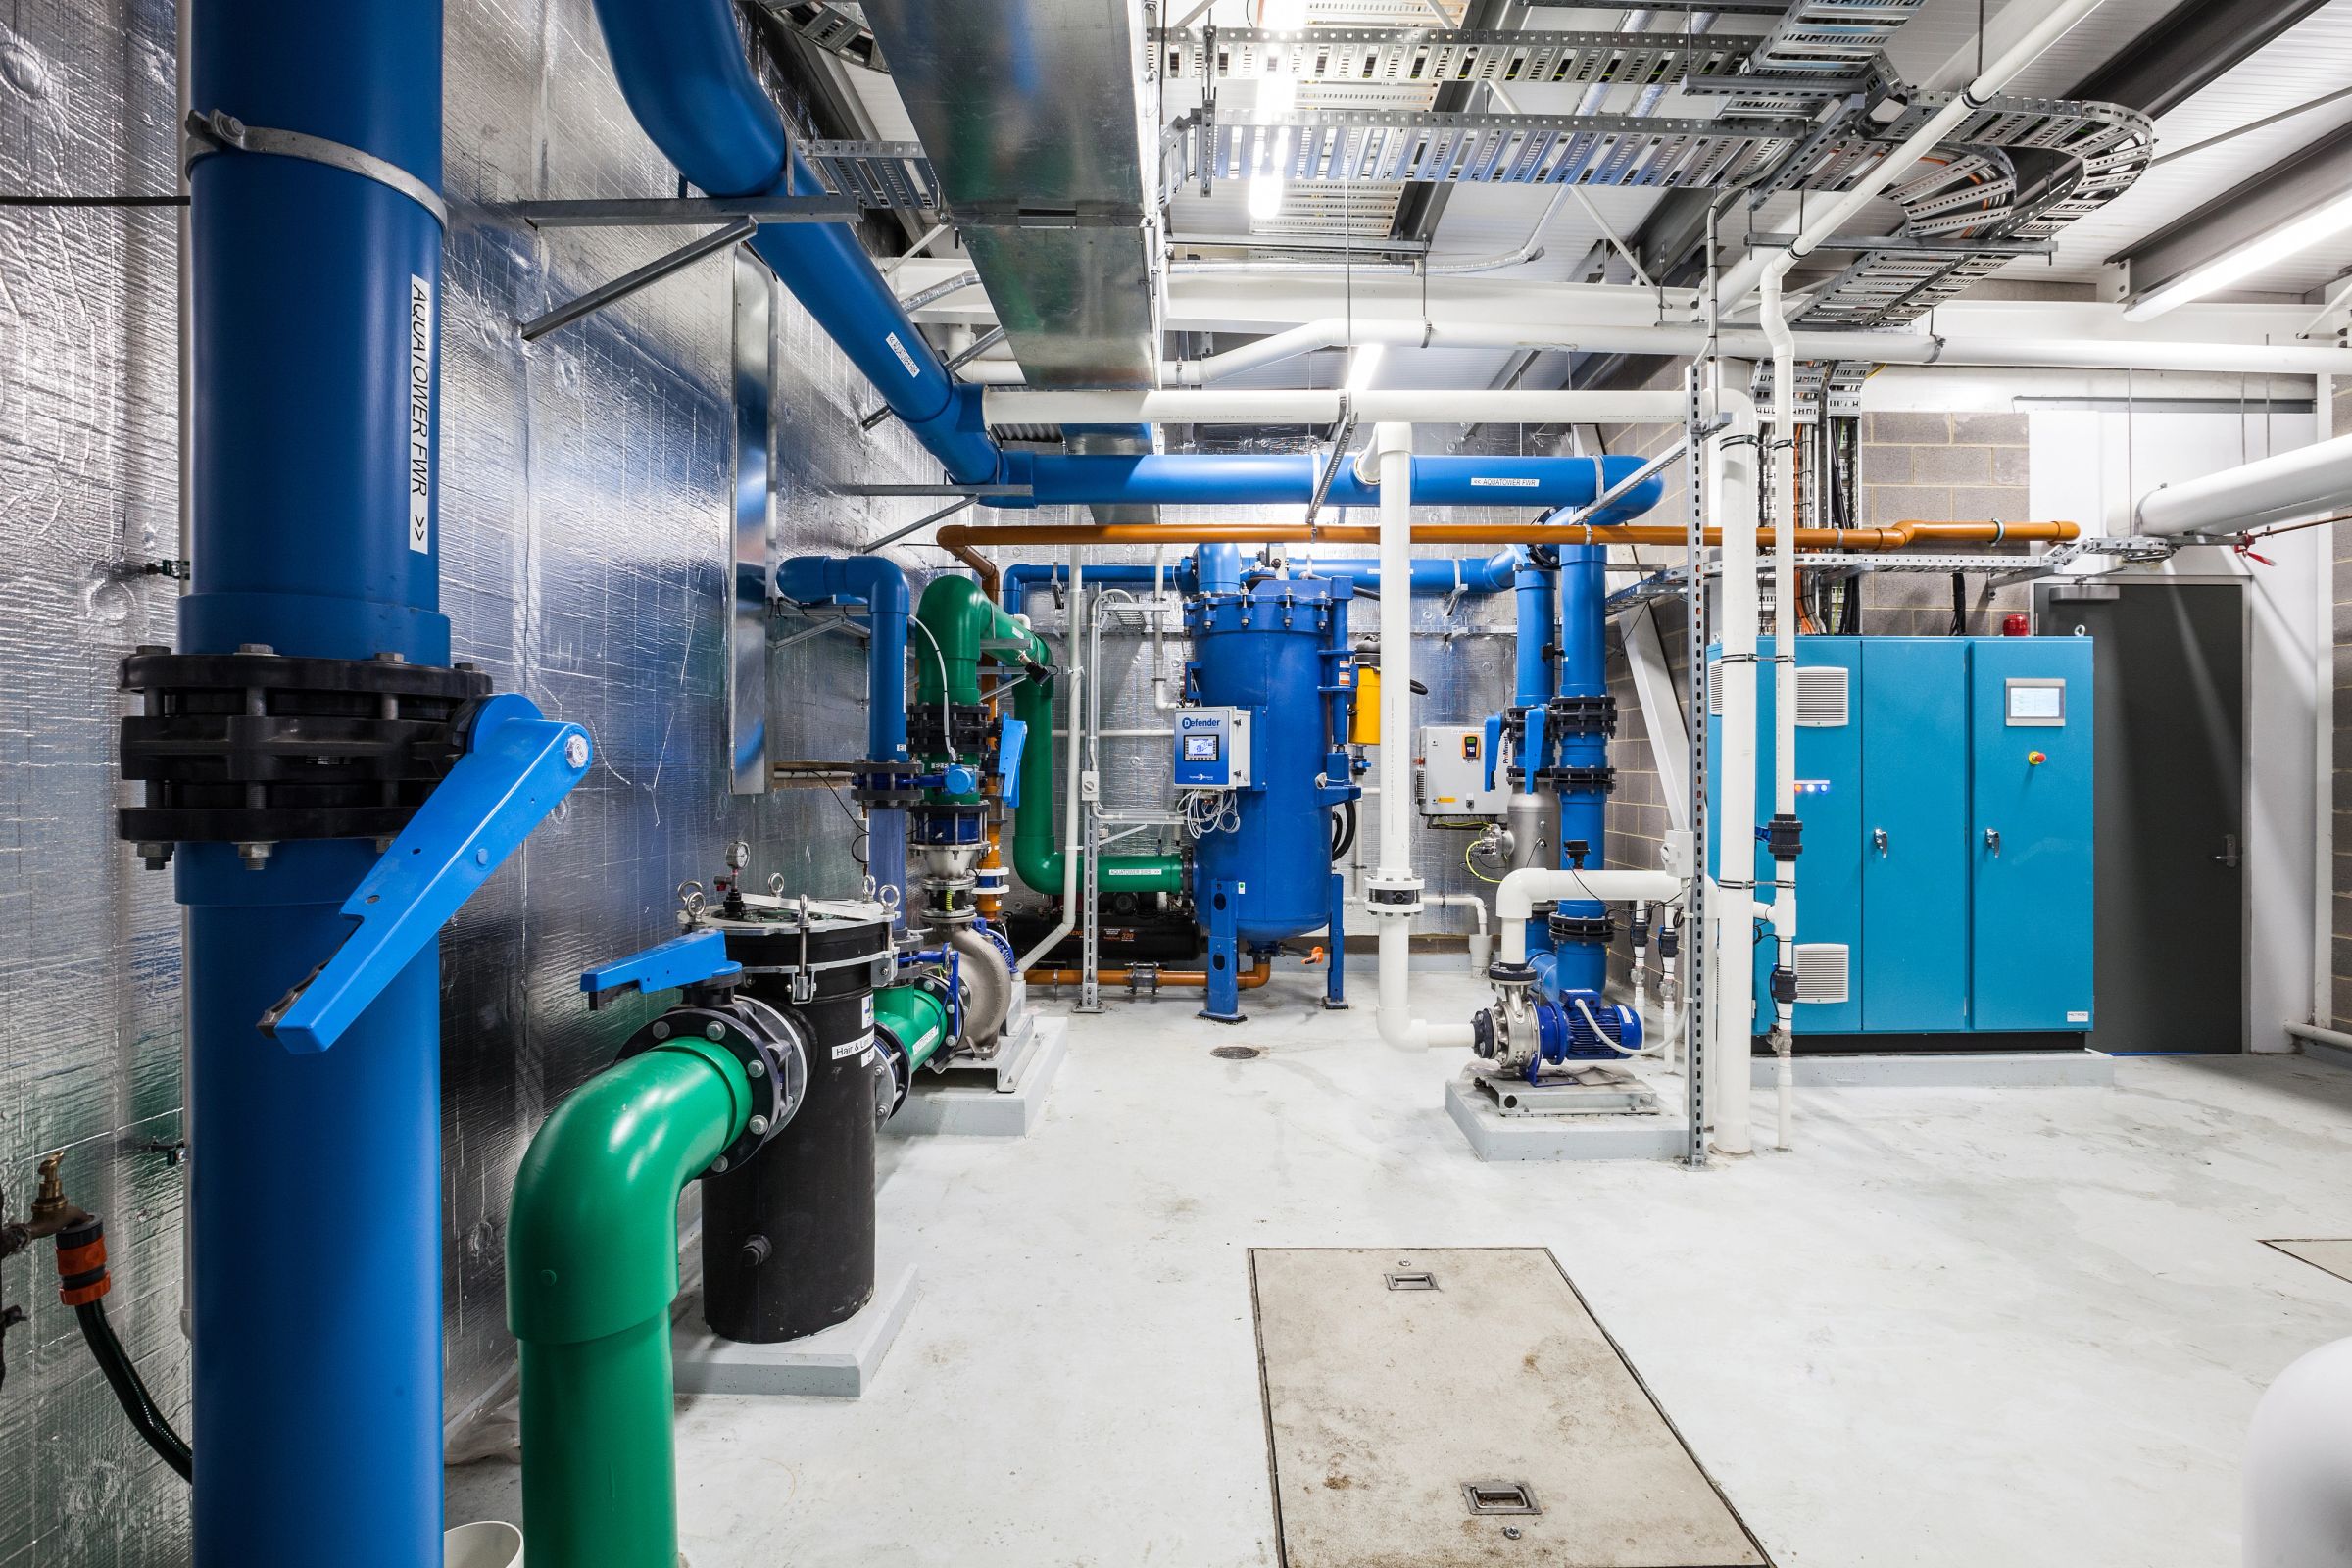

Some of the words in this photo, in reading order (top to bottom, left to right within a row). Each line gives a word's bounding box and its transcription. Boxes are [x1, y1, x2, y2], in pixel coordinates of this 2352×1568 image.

[413, 283, 429, 438] AQUATOWER
[412, 441, 428, 497] FWR
[1182, 716, 1221, 730] Defender
[836, 1045, 854, 1057] Hair
[854, 1042, 859, 1052] &
